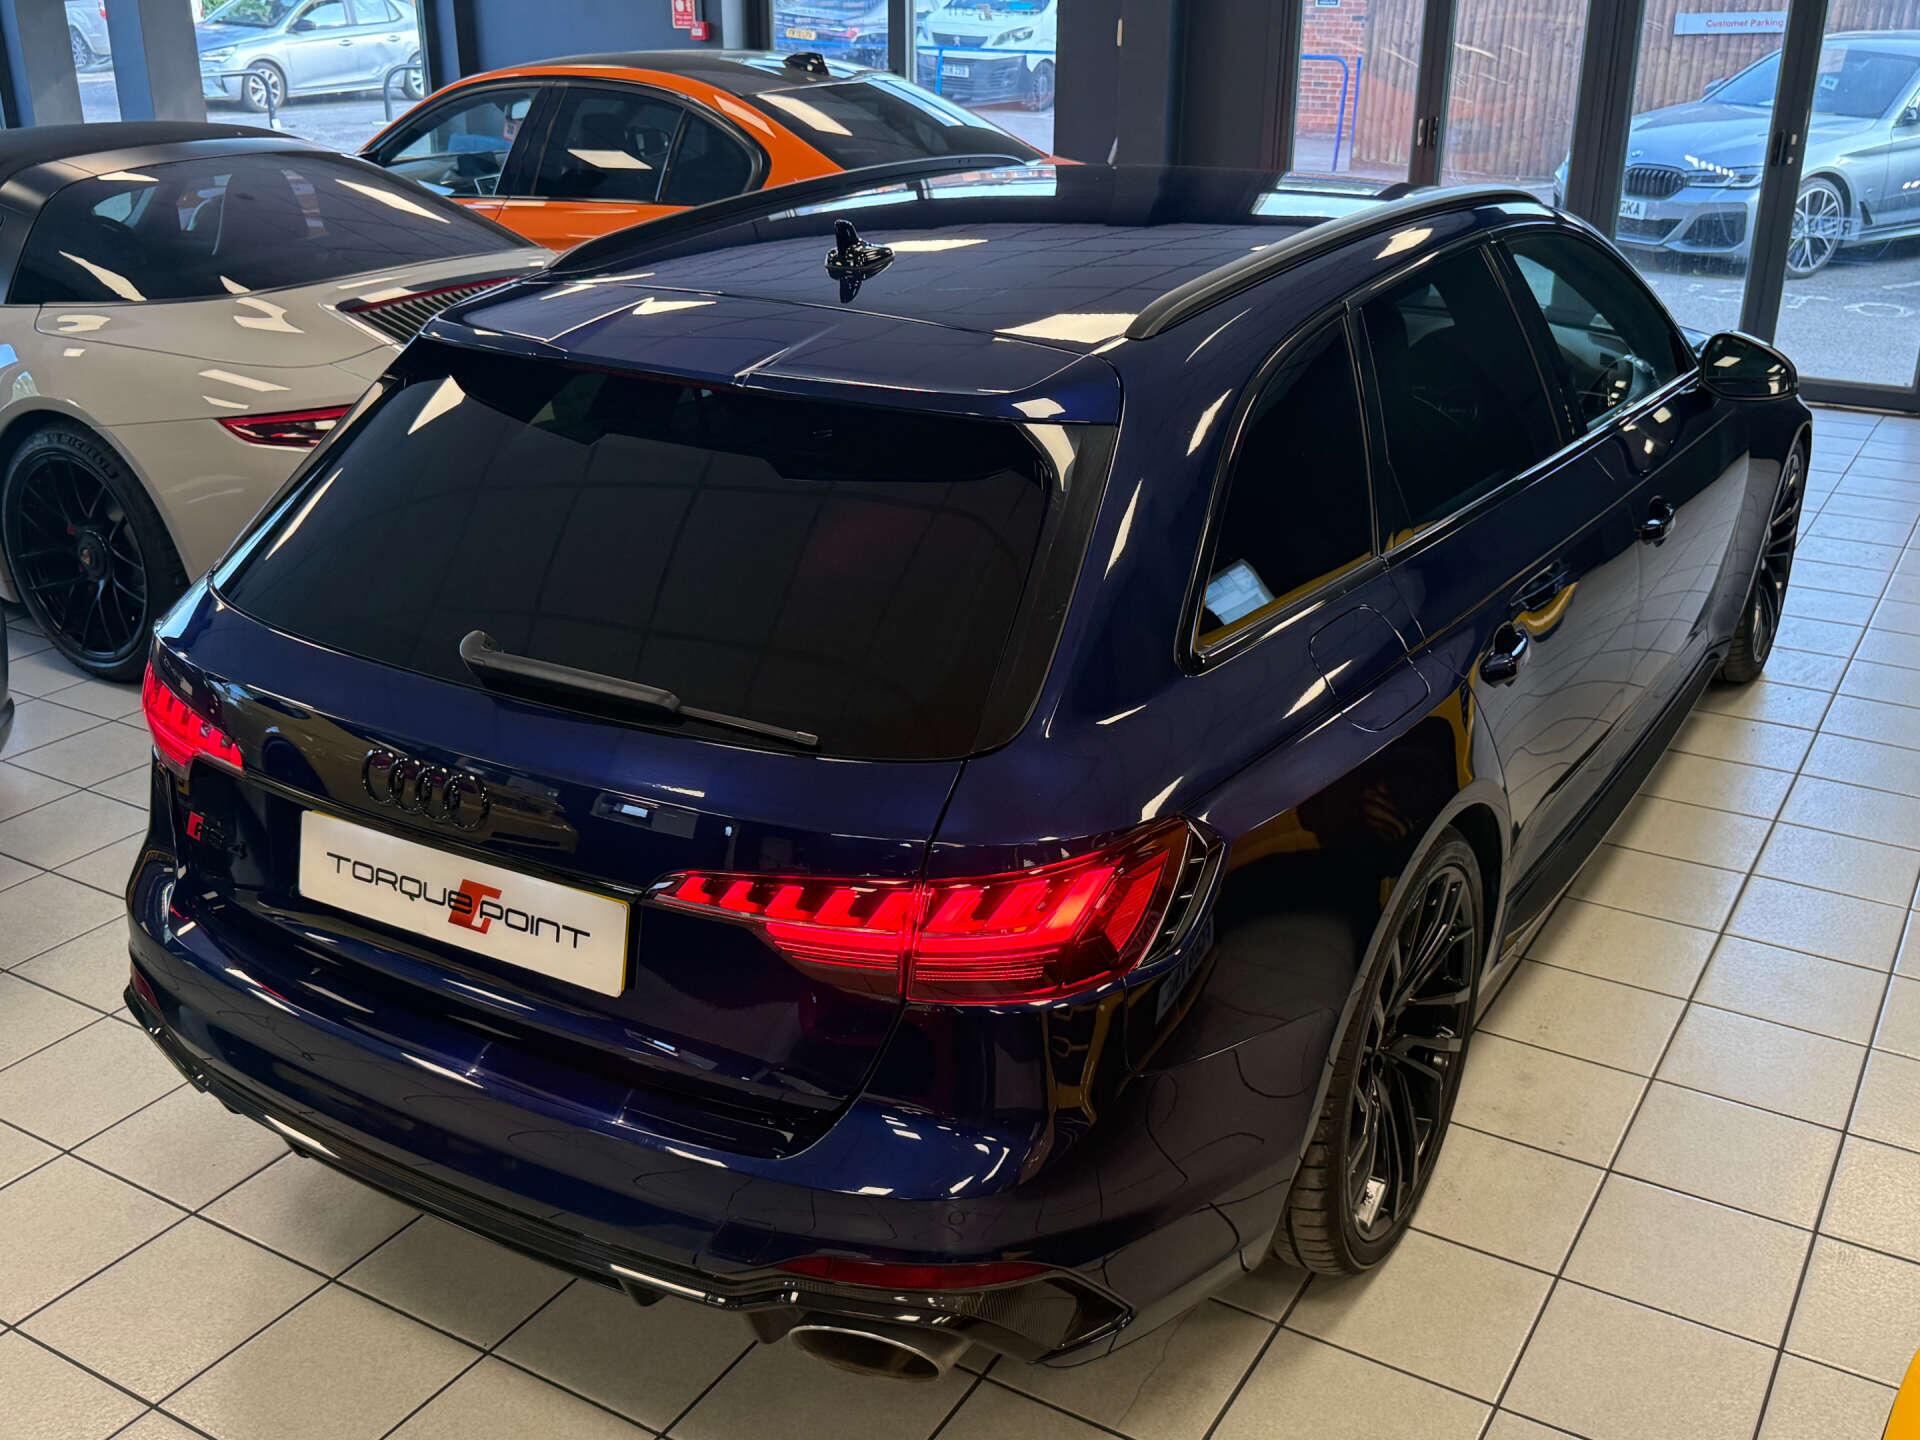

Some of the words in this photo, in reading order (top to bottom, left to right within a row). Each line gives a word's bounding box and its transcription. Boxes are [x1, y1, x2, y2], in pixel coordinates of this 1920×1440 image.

[1706, 19, 1748, 28] Customer
[1750, 18, 1784, 30] Parking
[326, 851, 473, 915] TORQUE
[479, 899, 591, 949] POINT
